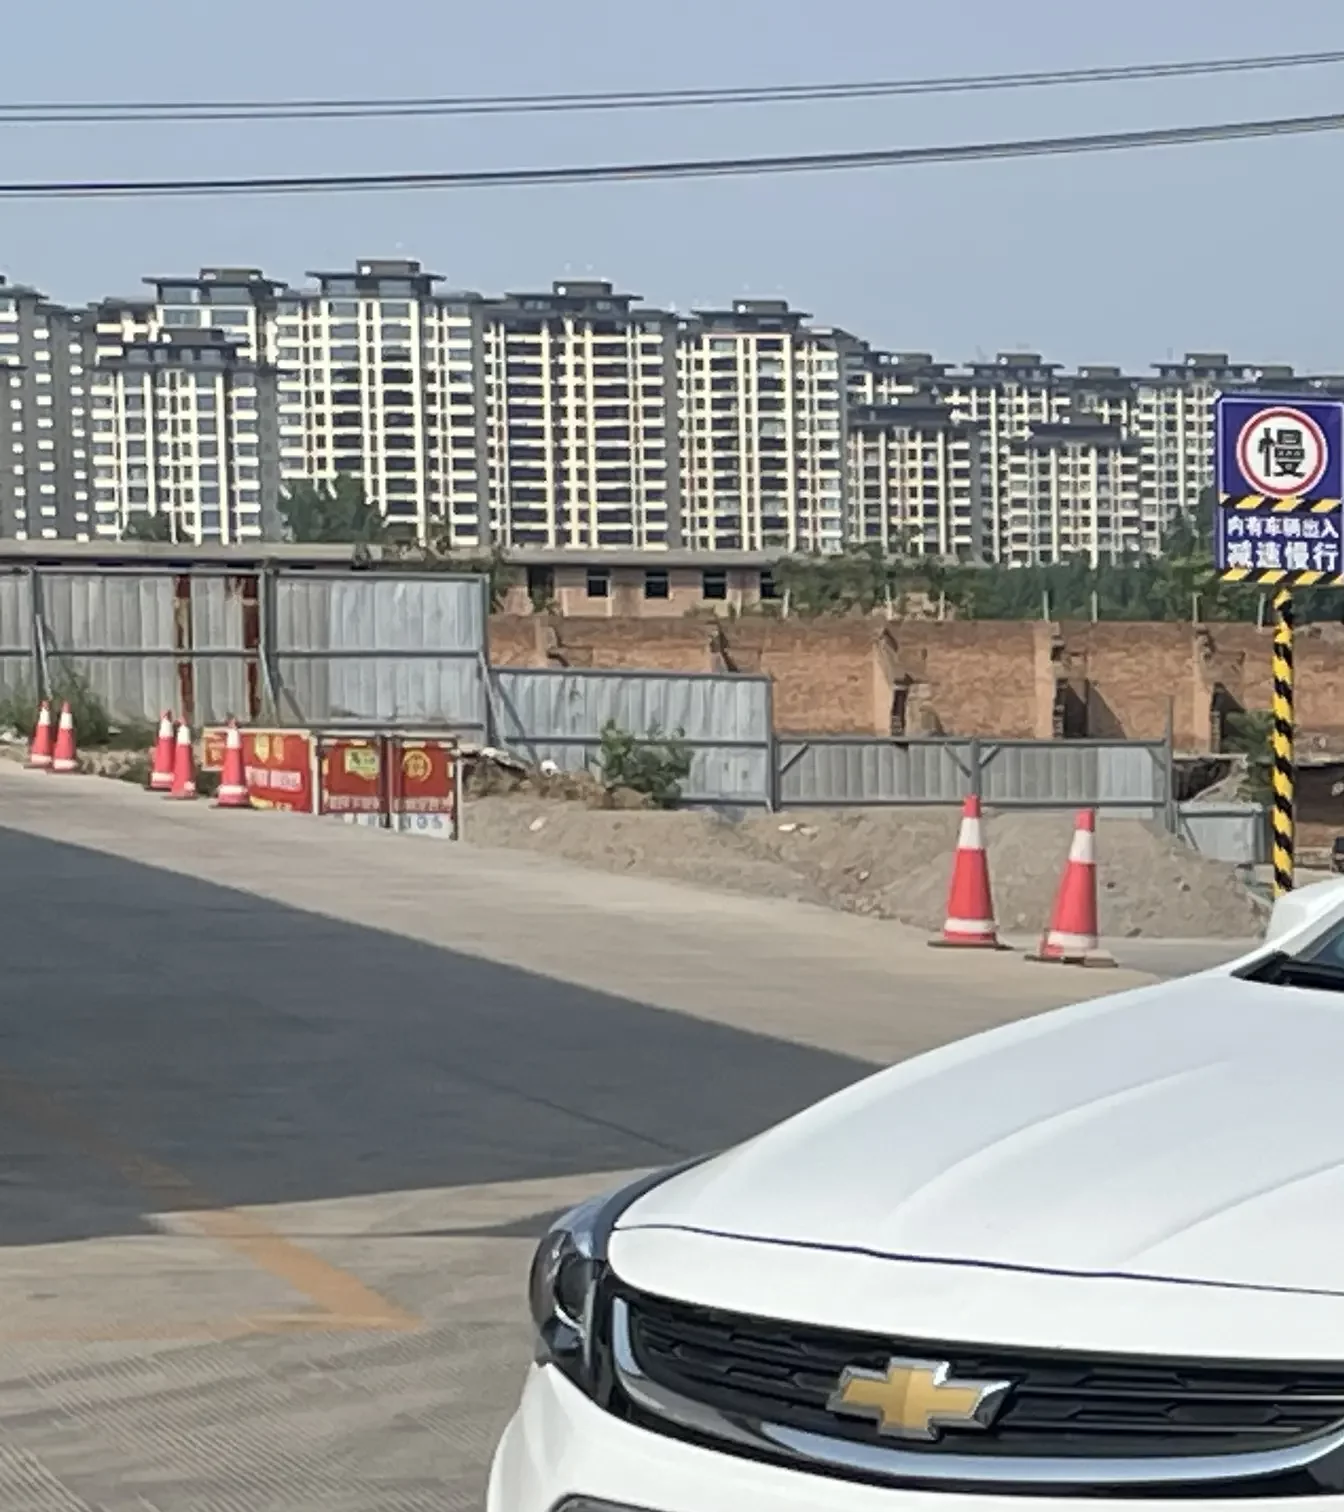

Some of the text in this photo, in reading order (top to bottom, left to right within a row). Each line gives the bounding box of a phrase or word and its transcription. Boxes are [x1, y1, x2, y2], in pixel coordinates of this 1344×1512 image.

[1257, 427, 1306, 477] 慢
[1226, 515, 1340, 539] 内有车辆出入
[1226, 540, 1340, 572] 减速慢行
